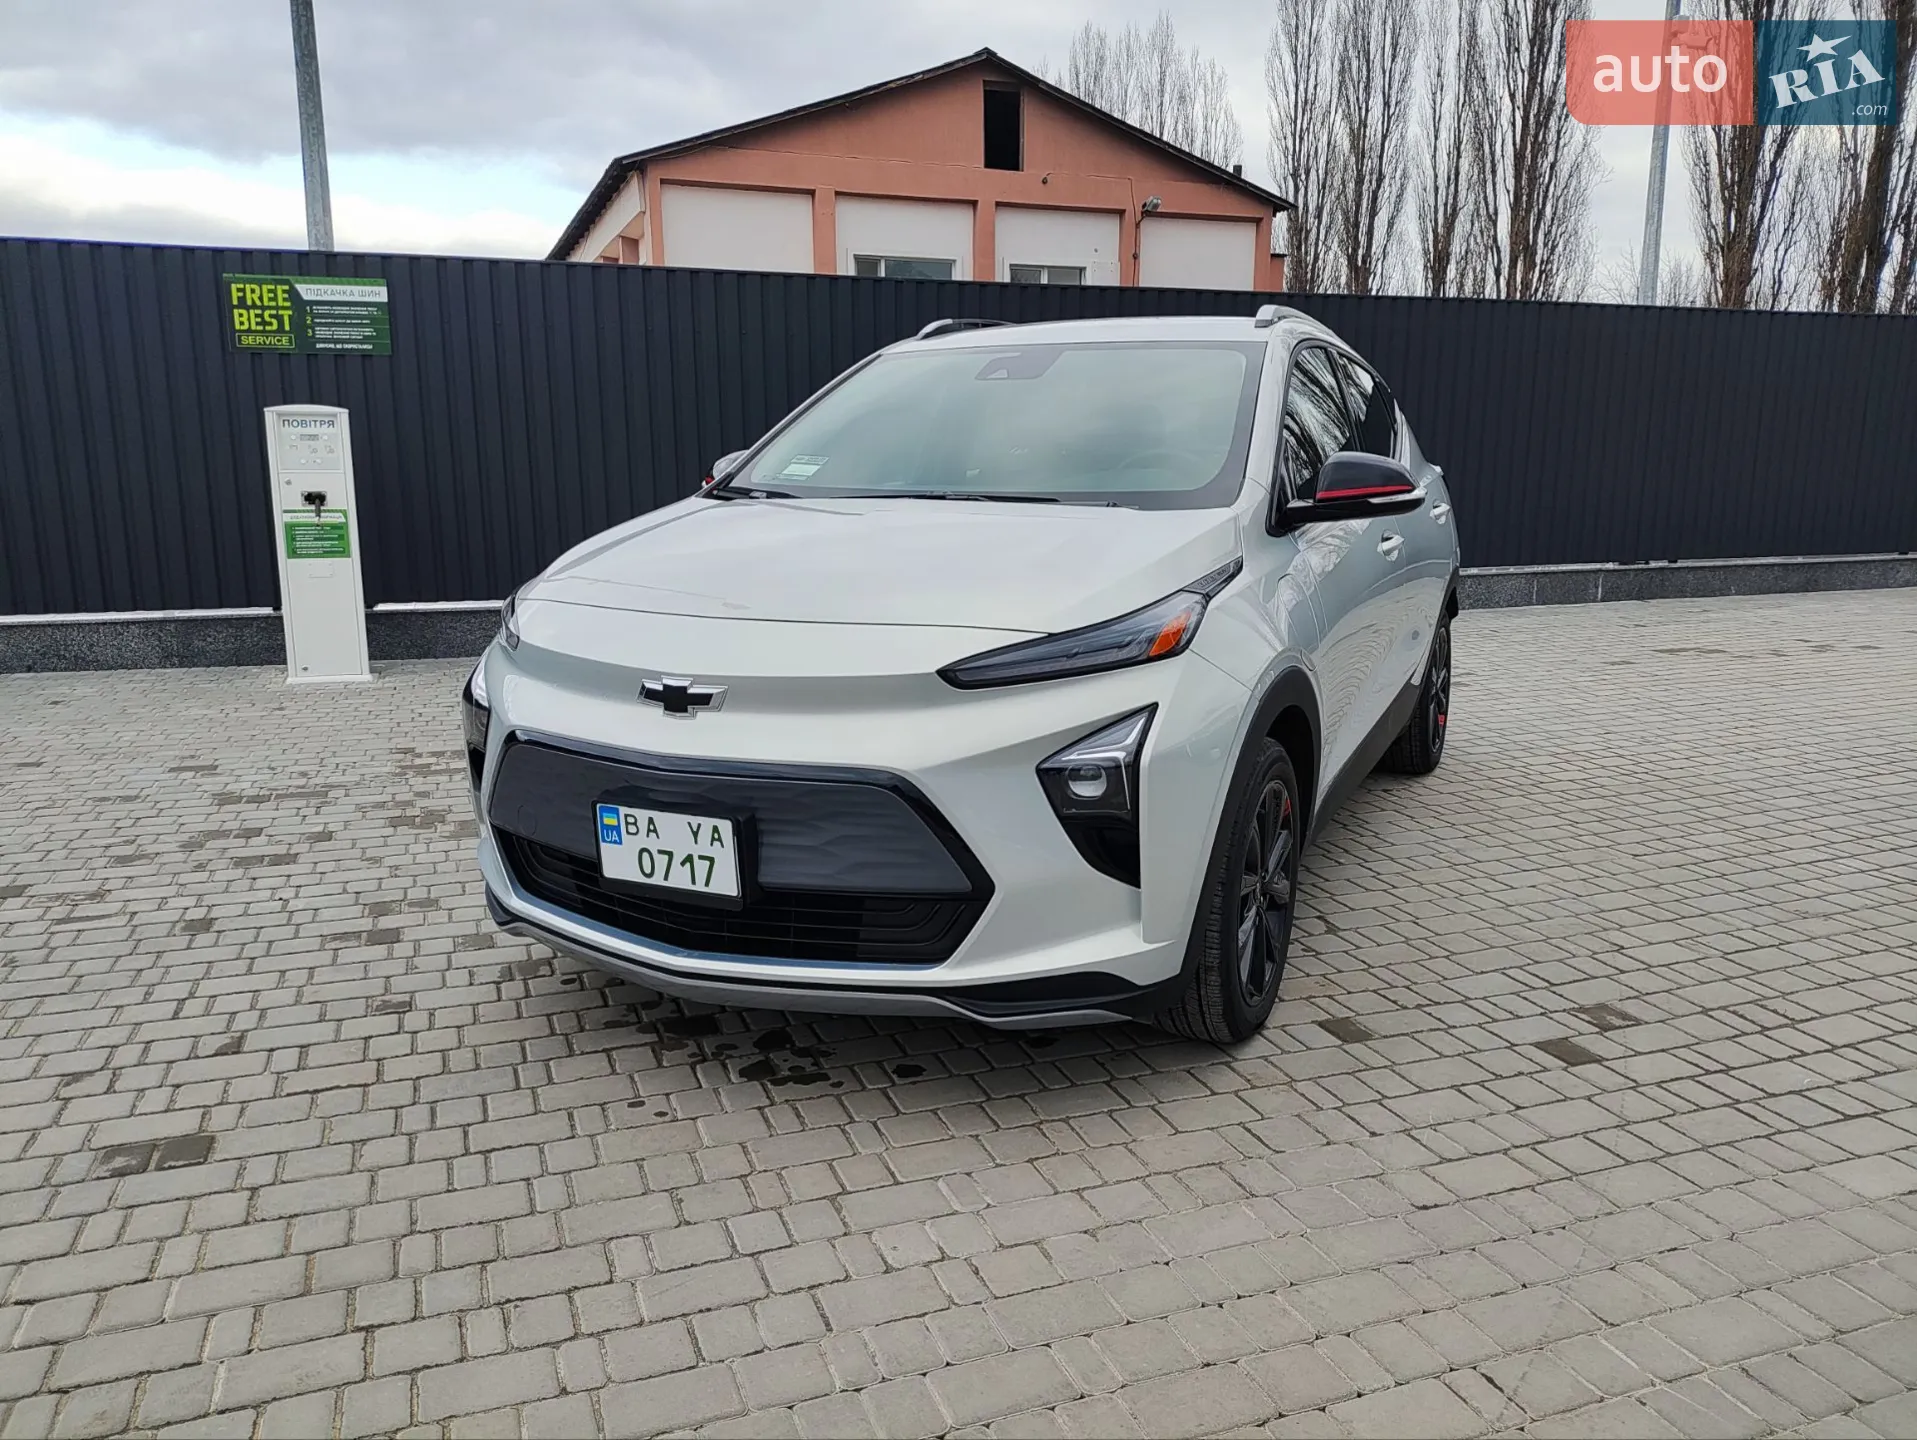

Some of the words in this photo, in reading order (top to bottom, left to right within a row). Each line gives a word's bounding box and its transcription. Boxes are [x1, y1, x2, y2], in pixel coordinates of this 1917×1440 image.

[230, 283, 292, 307] FREE
[305, 288, 355, 298] ПІДКАЧКА
[358, 289, 381, 298] ШИН
[233, 308, 293, 331] BEST
[305, 316, 312, 324] 2
[240, 335, 291, 346] SERVICE
[282, 419, 335, 428] ПОВІТРЯ
[603, 829, 620, 843] UA
[638, 847, 715, 888] 0717
